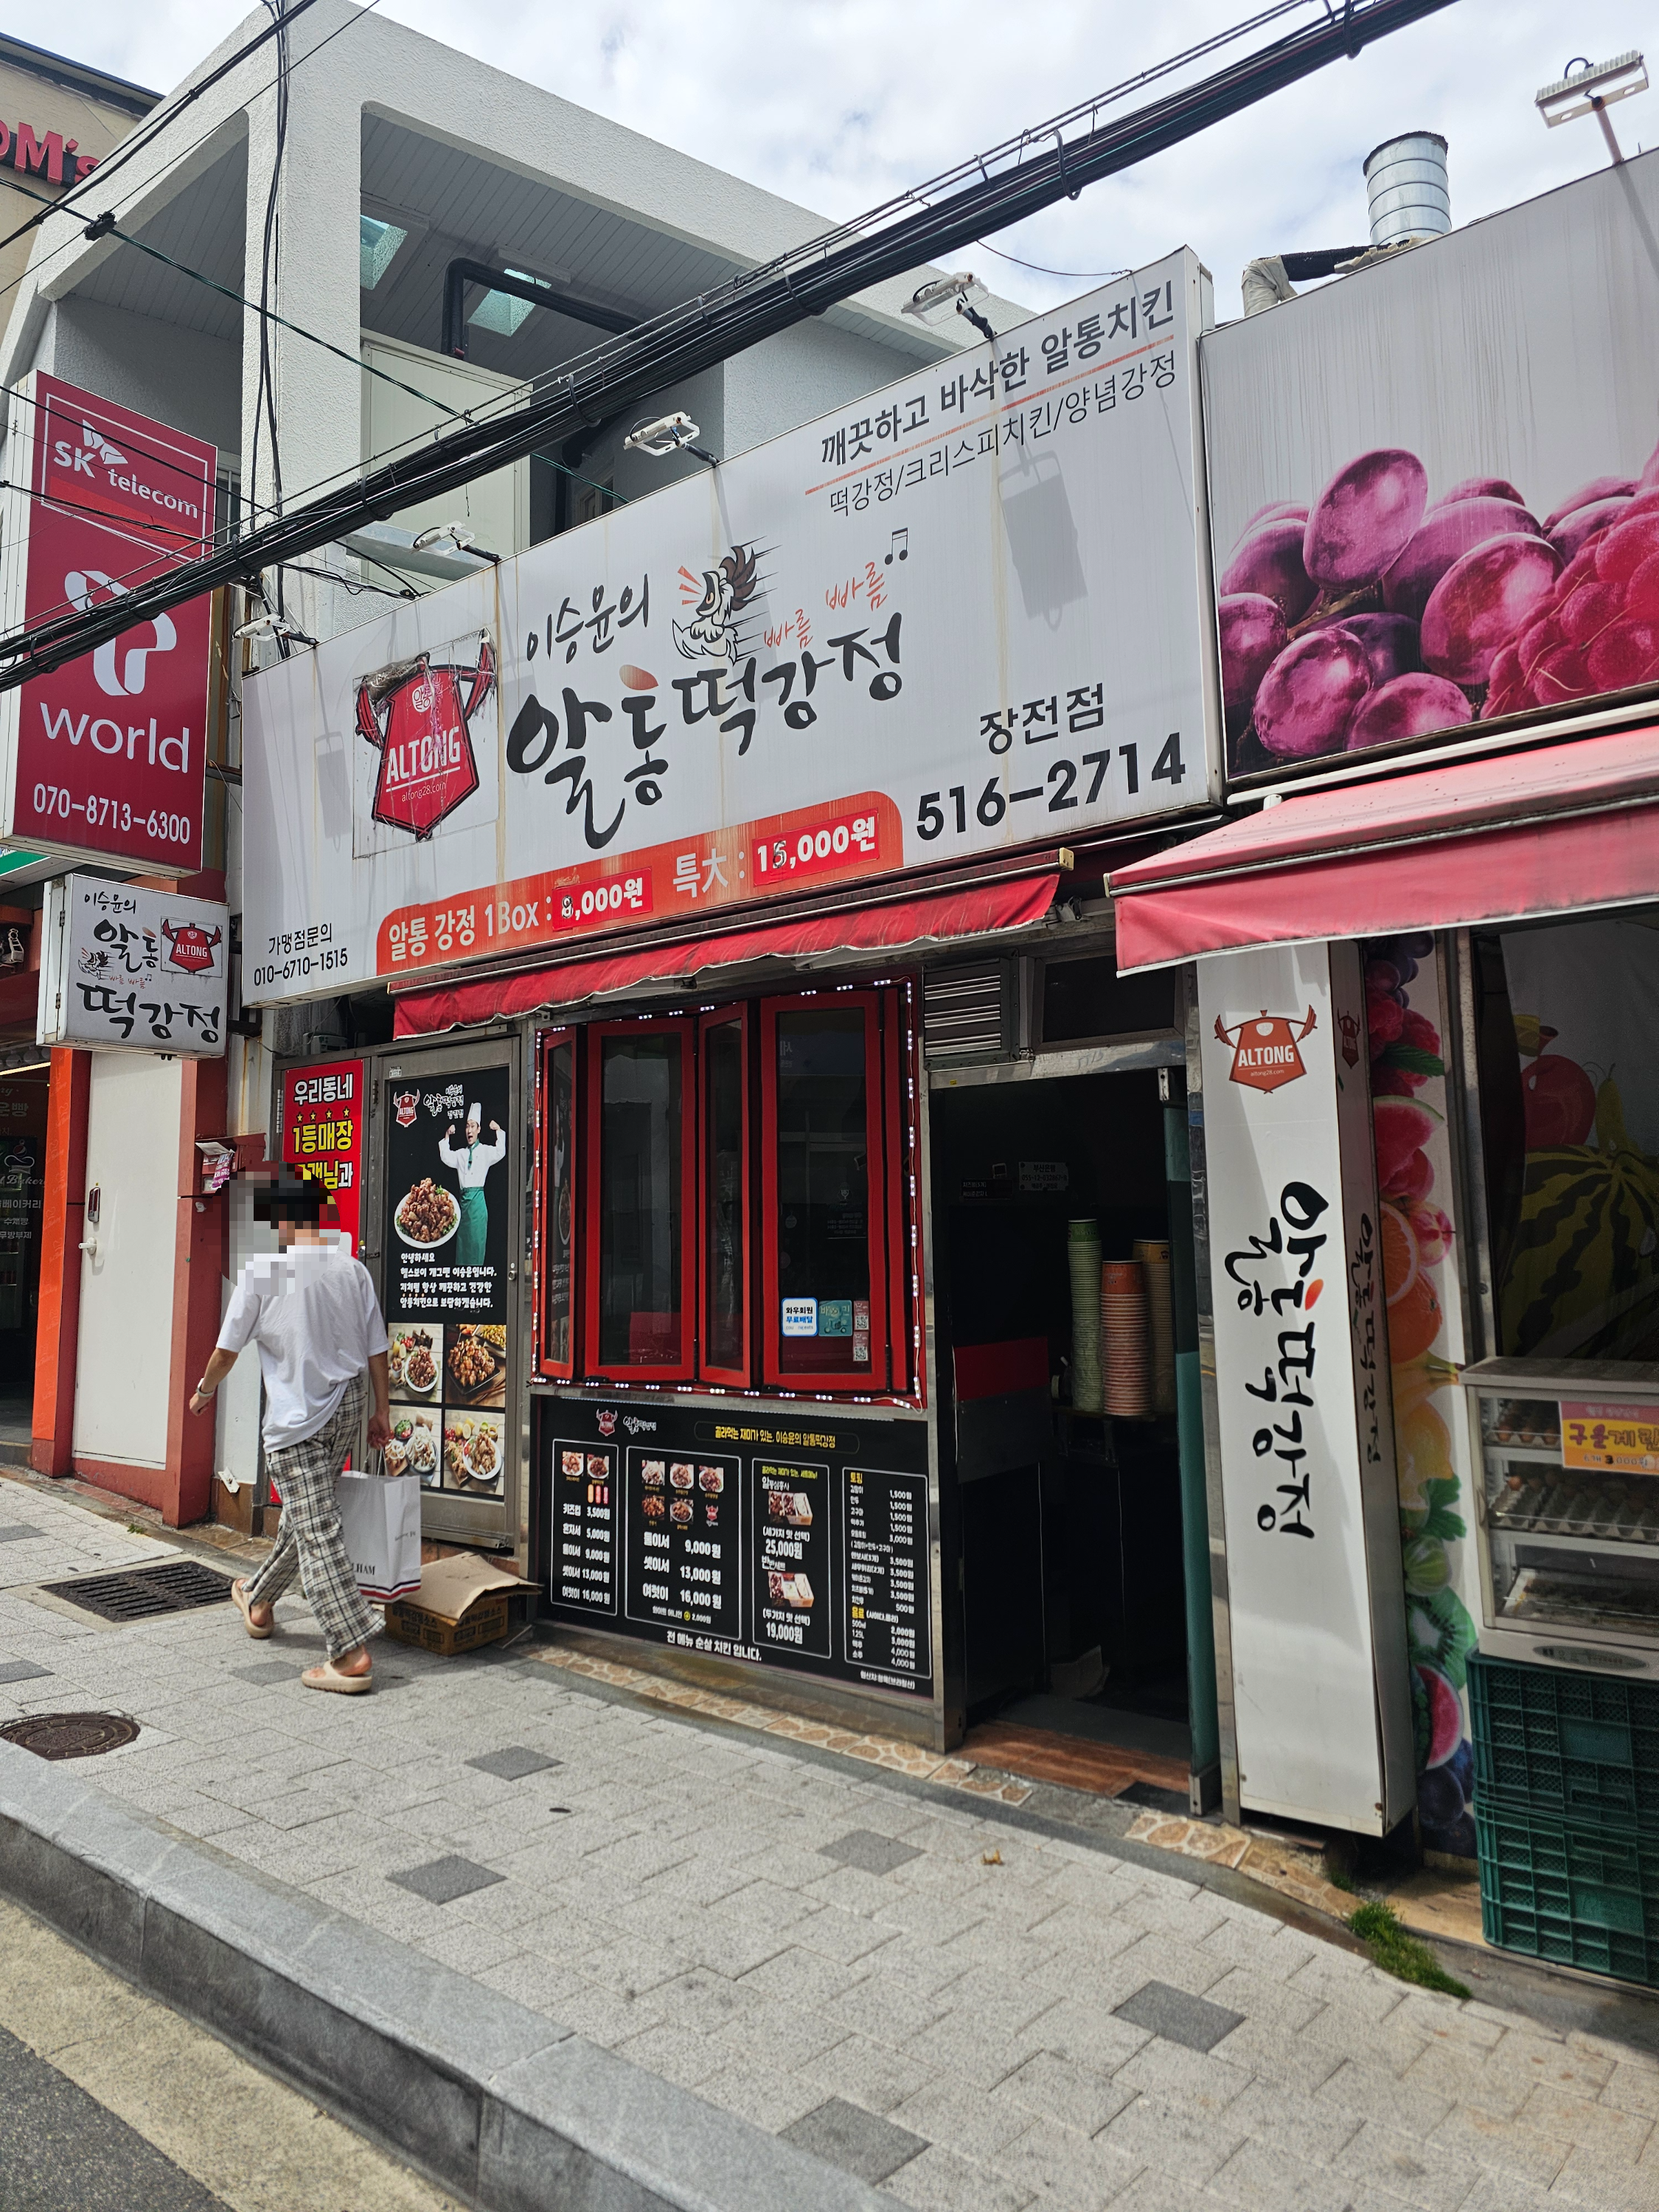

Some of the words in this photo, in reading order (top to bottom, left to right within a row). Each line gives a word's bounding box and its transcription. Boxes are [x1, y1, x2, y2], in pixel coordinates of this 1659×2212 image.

[821, 394, 930, 466] 깨끗하고
[940, 347, 1030, 414] 바삭한
[1040, 279, 1175, 375] 알통치킨
[53, 441, 96, 479] SK
[107, 468, 198, 518] telecom
[526, 574, 649, 664] 이승윤의
[981, 683, 1105, 755] 장전점
[40, 702, 189, 773] world
[386, 726, 460, 785] ALTONG
[401, 782, 445, 801] altong28.com
[916, 731, 1186, 841] 516-2714
[33, 783, 190, 844] 070-8713-6300
[84, 891, 136, 914] 이승윤의
[94, 919, 159, 973] 알통
[389, 917, 428, 961] 알통
[435, 905, 476, 950] 강정
[175, 944, 207, 958] ALTONG
[254, 947, 348, 987] 010-6710-1515
[76, 982, 220, 1044] 떡강정
[1238, 1045, 1294, 1067] ALTONG
[1251, 1069, 1284, 1077] altong28.com
[294, 1074, 353, 1105] 우리동네
[293, 1120, 353, 1154] 1등매장
[0, 1199, 41, 1209] 베이커리
[400, 1253, 435, 1265] 안녕하세요
[429, 1267, 451, 1278] 개그맨
[422, 1282, 437, 1293] 항상
[439, 1282, 467, 1293] 깨끗하고
[469, 1281, 493, 1293] 건강한
[786, 1307, 813, 1315] 와우회원
[786, 1315, 813, 1324] 무료배달
[715, 1426, 739, 1439] 골라먹는
[740, 1428, 759, 1441] 재미가
[776, 1431, 801, 1445] 이승윤의
[802, 1433, 835, 1449] 알통떡강정
[563, 1503, 581, 1517] 키즈컵
[587, 1506, 611, 1520] 3,500원
[644, 1531, 669, 1549] 둘이서
[685, 1540, 721, 1559] 9,000원
[765, 1538, 803, 1560] 25,000원
[644, 1556, 669, 1573] 셋이서
[680, 1565, 721, 1585] 13,000원
[642, 1583, 669, 1601] 여럿이
[680, 1589, 722, 1610] 16,000원
[667, 1630, 675, 1644] 전
[677, 1632, 693, 1647] 메뉴
[695, 1636, 712, 1652] 순살
[714, 1640, 731, 1655] 치킨
[733, 1644, 762, 1661] 입니다.
[766, 1621, 803, 1644] 19,000원
